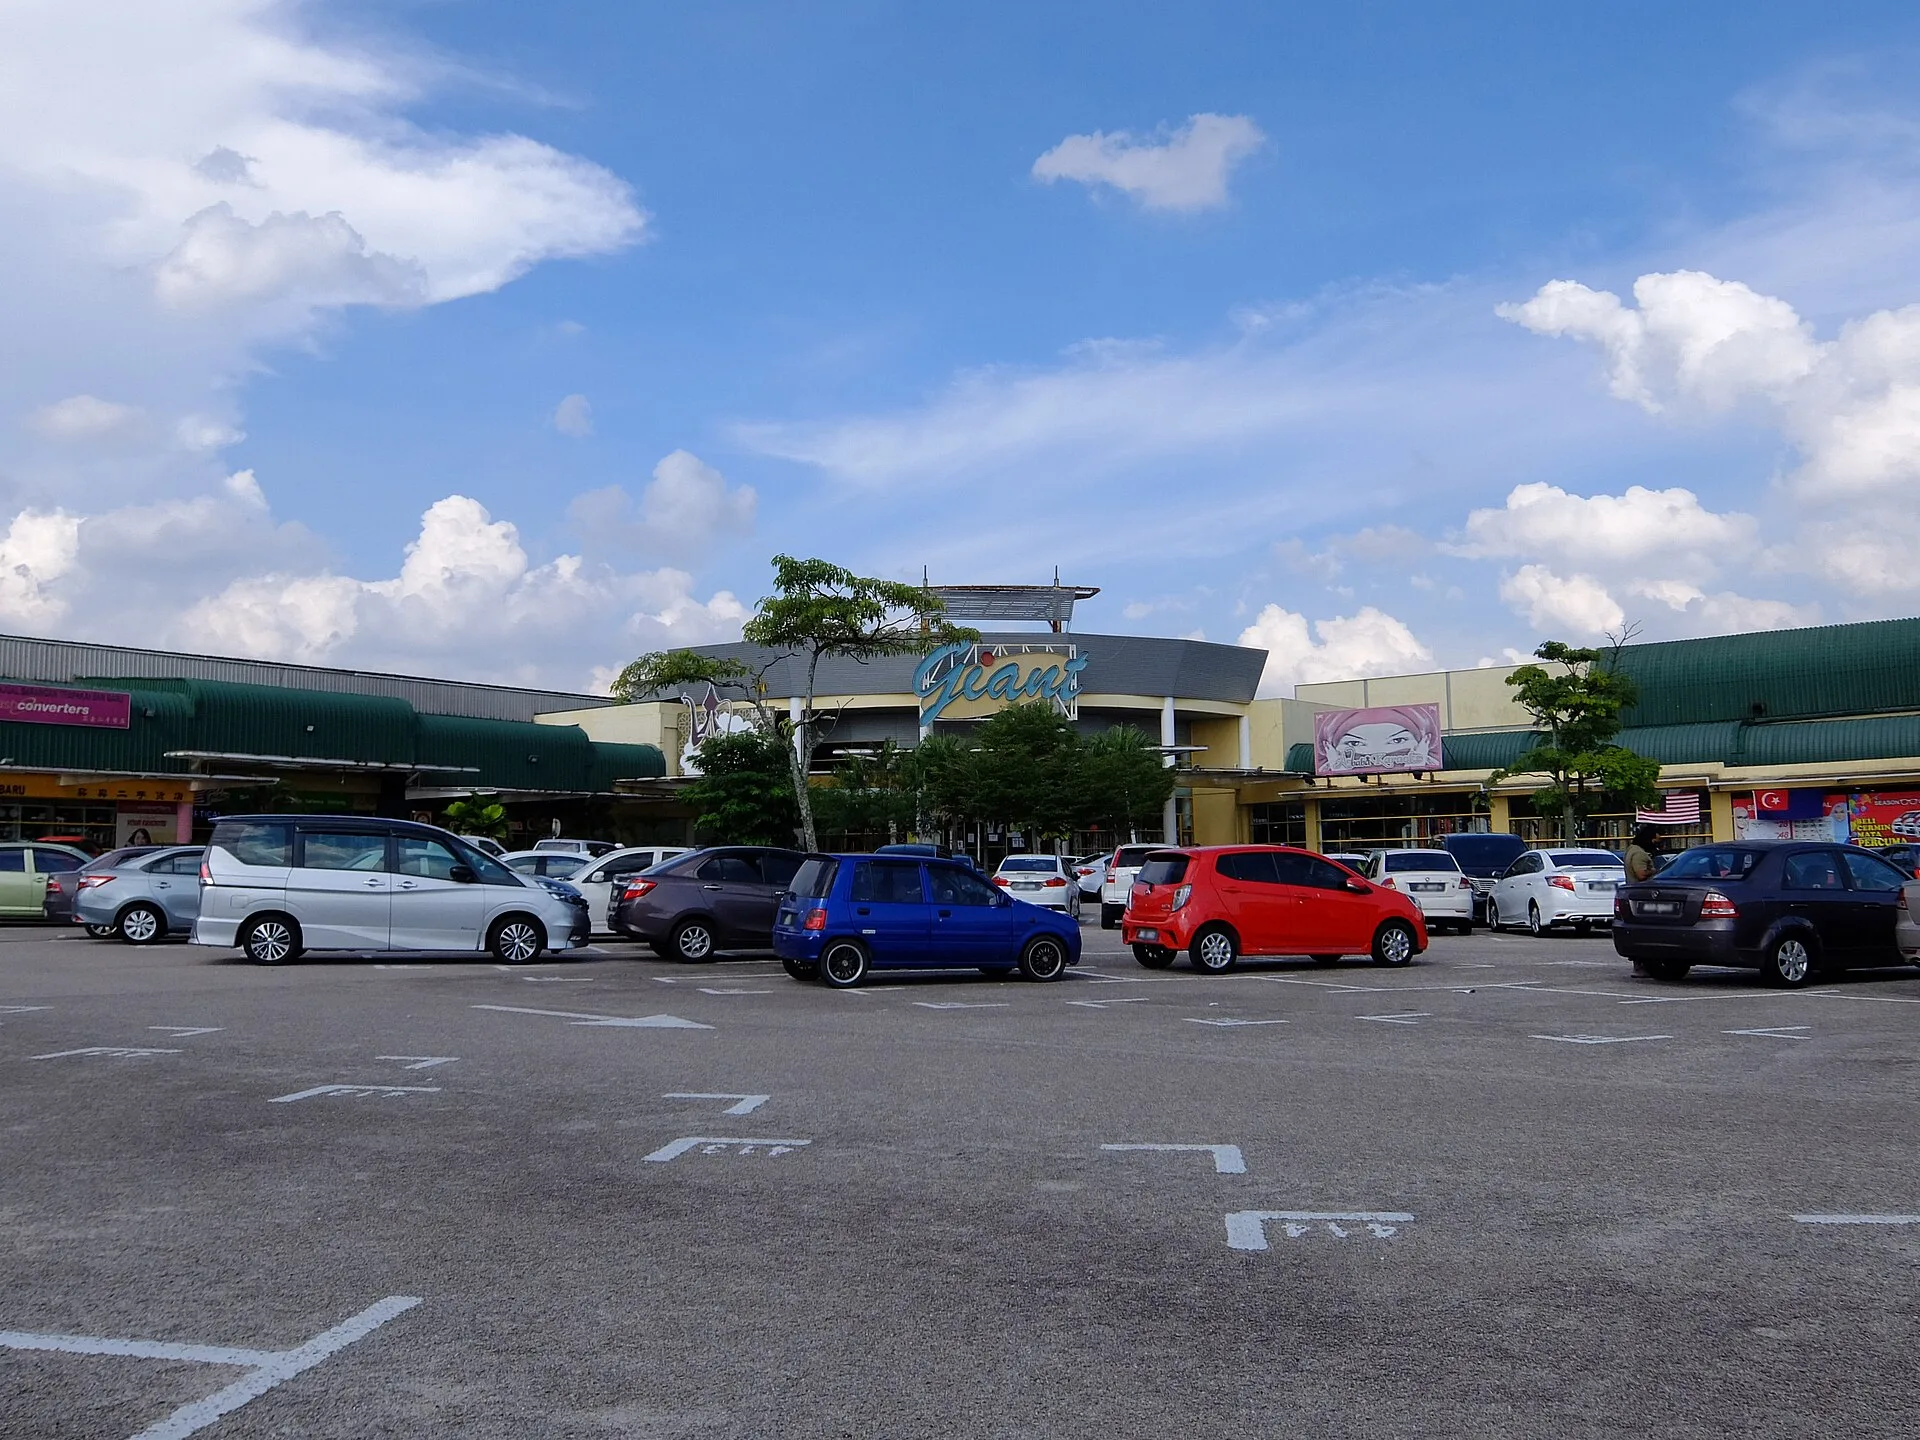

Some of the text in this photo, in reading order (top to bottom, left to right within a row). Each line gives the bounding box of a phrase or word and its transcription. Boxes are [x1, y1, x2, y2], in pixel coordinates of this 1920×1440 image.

[17, 702, 89, 715] converters
[0, 784, 25, 795] BARU
[1856, 817, 1876, 825] BELI
[1857, 837, 1908, 847] PERCUMA
